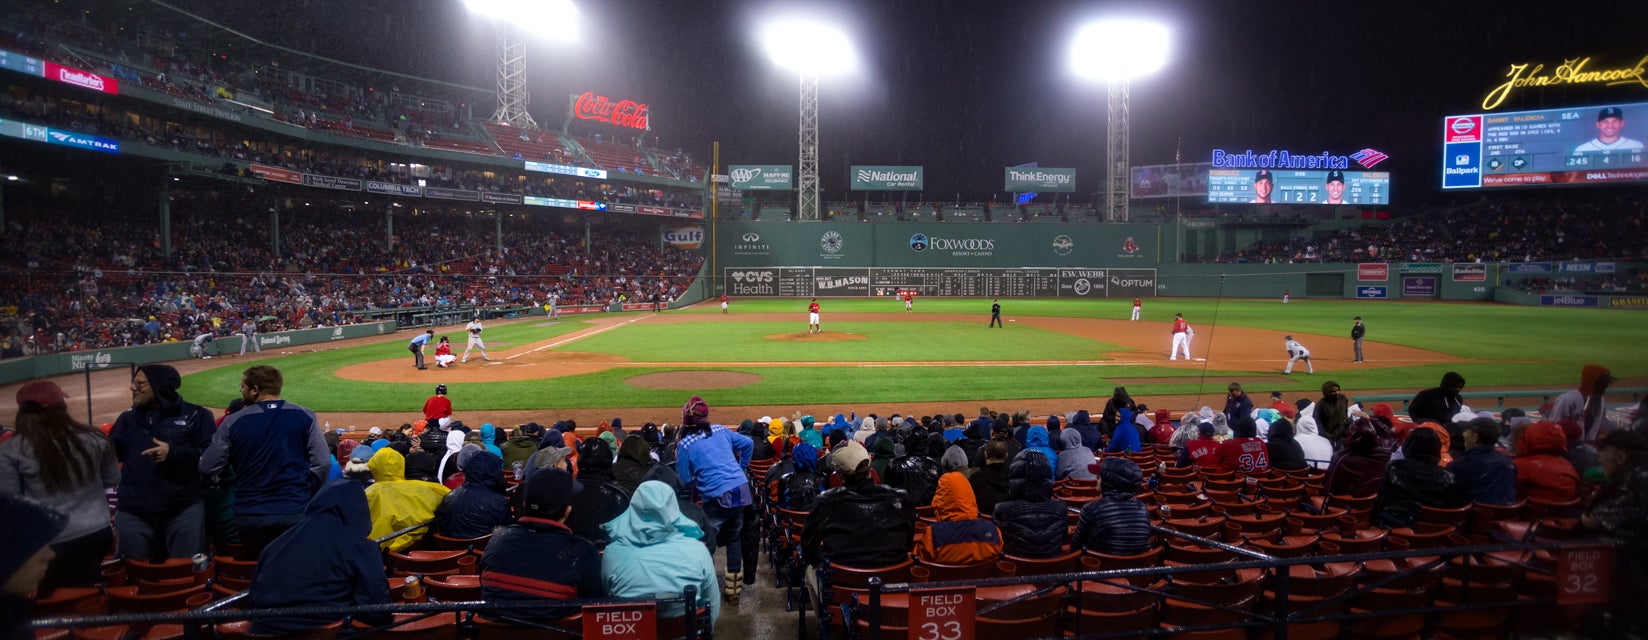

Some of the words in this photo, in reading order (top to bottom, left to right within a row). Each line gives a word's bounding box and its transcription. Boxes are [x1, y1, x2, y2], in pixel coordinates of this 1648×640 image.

[1482, 63, 1550, 110] John
[1552, 54, 1648, 88] Hancock
[1561, 112, 1579, 120] SEA
[26, 127, 45, 138] 6TH
[69, 137, 117, 150] AMTRAK
[1212, 149, 1257, 168] Bank
[1258, 150, 1278, 169] of
[1278, 150, 1349, 169] America
[1566, 157, 1588, 166] .245
[1602, 156, 1609, 164] 4
[1631, 154, 1641, 162] 16
[870, 171, 917, 181] National
[1446, 166, 1478, 175] Ballpark
[1586, 172, 1608, 180] DELL
[1009, 171, 1070, 184] ThinkEnergy
[368, 182, 401, 192] COLUMBIA
[402, 185, 419, 193] TECH
[1284, 191, 1288, 202] 1
[1296, 191, 1303, 202] 2
[1310, 191, 1317, 202] 2
[664, 230, 703, 243] Gulf
[1566, 263, 1591, 272] NESN
[745, 271, 774, 283] CVS
[733, 283, 773, 294] Health
[1120, 279, 1153, 287] OPTUM
[1553, 296, 1584, 305] jetBlue
[276, 335, 291, 345] Spring
[71, 354, 94, 362] Ninety
[1239, 451, 1267, 472] 34
[1567, 550, 1600, 561] FIELD
[1570, 561, 1594, 571] BOX
[1564, 574, 1597, 593] 32
[921, 594, 963, 606] FIELD
[596, 611, 643, 623] FIELD
[926, 606, 956, 617] BOX
[602, 623, 636, 635] BOX
[918, 620, 962, 640] 33
